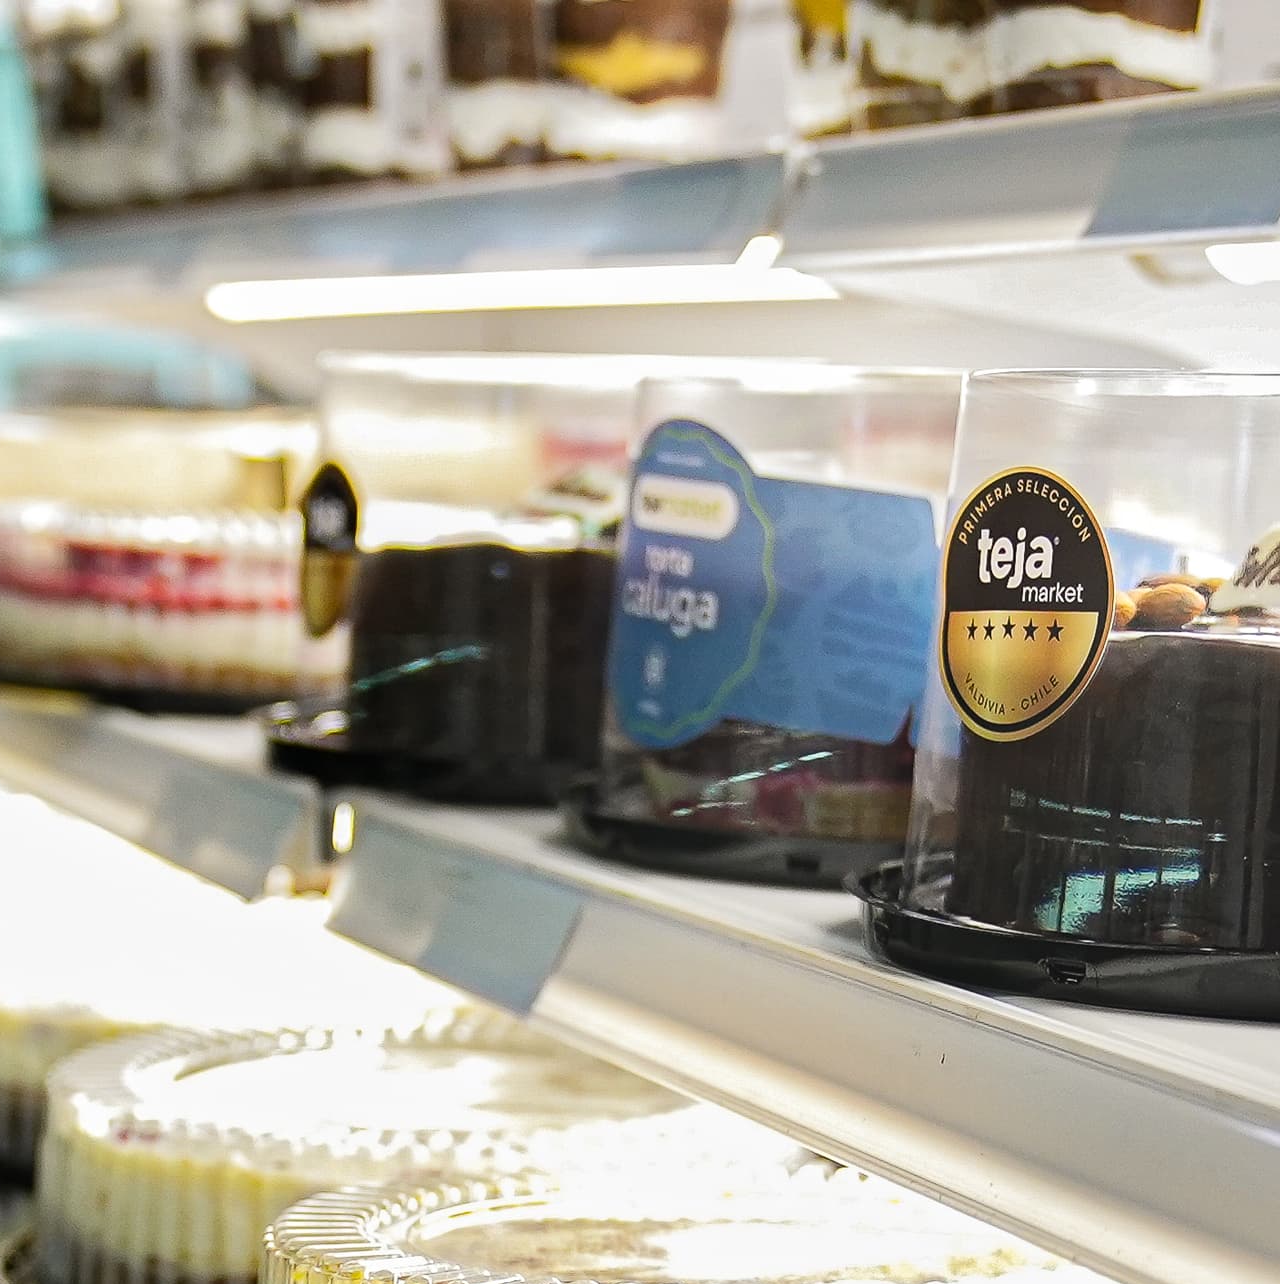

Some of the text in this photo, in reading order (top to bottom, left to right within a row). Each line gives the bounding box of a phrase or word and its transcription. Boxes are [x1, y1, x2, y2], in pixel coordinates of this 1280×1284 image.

[958, 479, 1090, 544] PRIMERA SELECCIÓN
[977, 527, 1054, 589] teja
[623, 576, 719, 637] caluga
[1022, 583, 1083, 604] market
[964, 673, 1006, 716] VALDIVIA
[1020, 673, 1059, 712] CHILE
